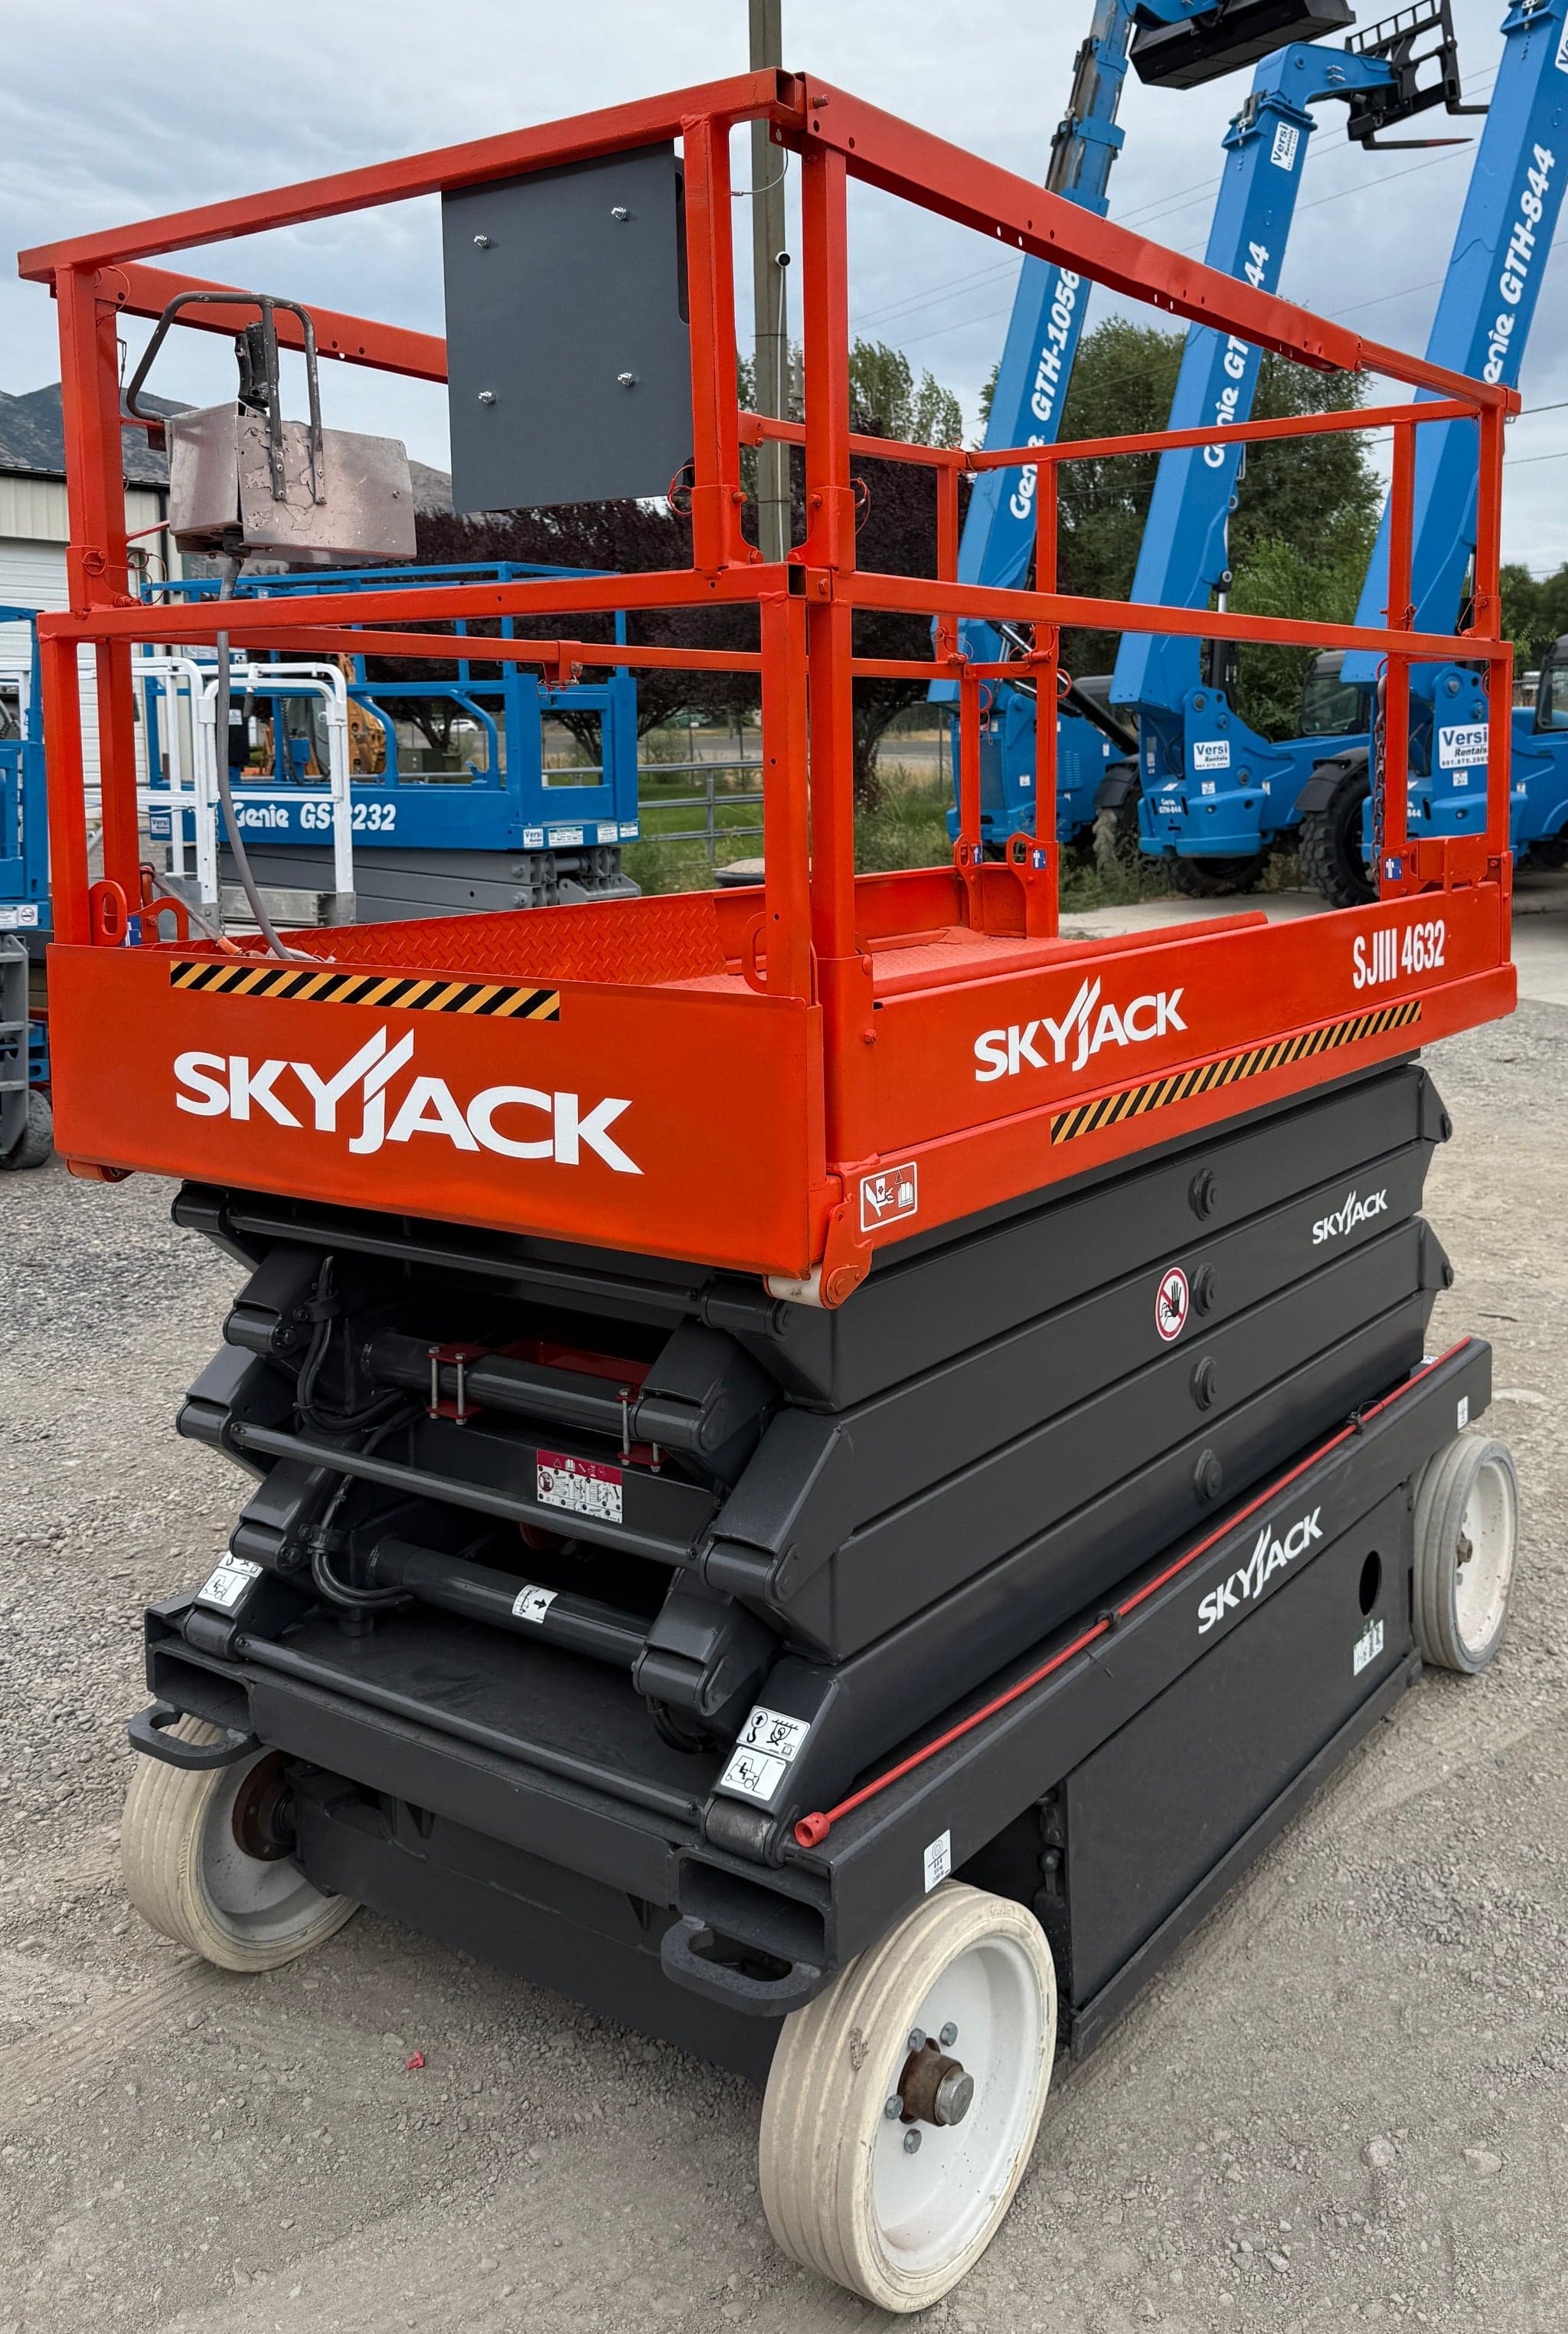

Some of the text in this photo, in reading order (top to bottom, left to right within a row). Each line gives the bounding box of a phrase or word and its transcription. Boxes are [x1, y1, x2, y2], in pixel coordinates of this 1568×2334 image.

[1483, 142, 1555, 384] enie GTH-844
[1010, 267, 1080, 519] Gene GTH-1056
[1204, 387, 1239, 468] Gnie
[1196, 743, 1228, 756] Versi
[1442, 727, 1488, 747] Versi
[1454, 744, 1488, 757] Rentals
[232, 802, 397, 831] Genie GS-232
[1353, 919, 1445, 989] SJIII 4632
[974, 975, 1188, 1082] SKYJACK
[174, 1025, 645, 1175] SKYJACK
[1312, 1188, 1388, 1244] SKYJACK
[1197, 1506, 1323, 1634] SKYJACK
